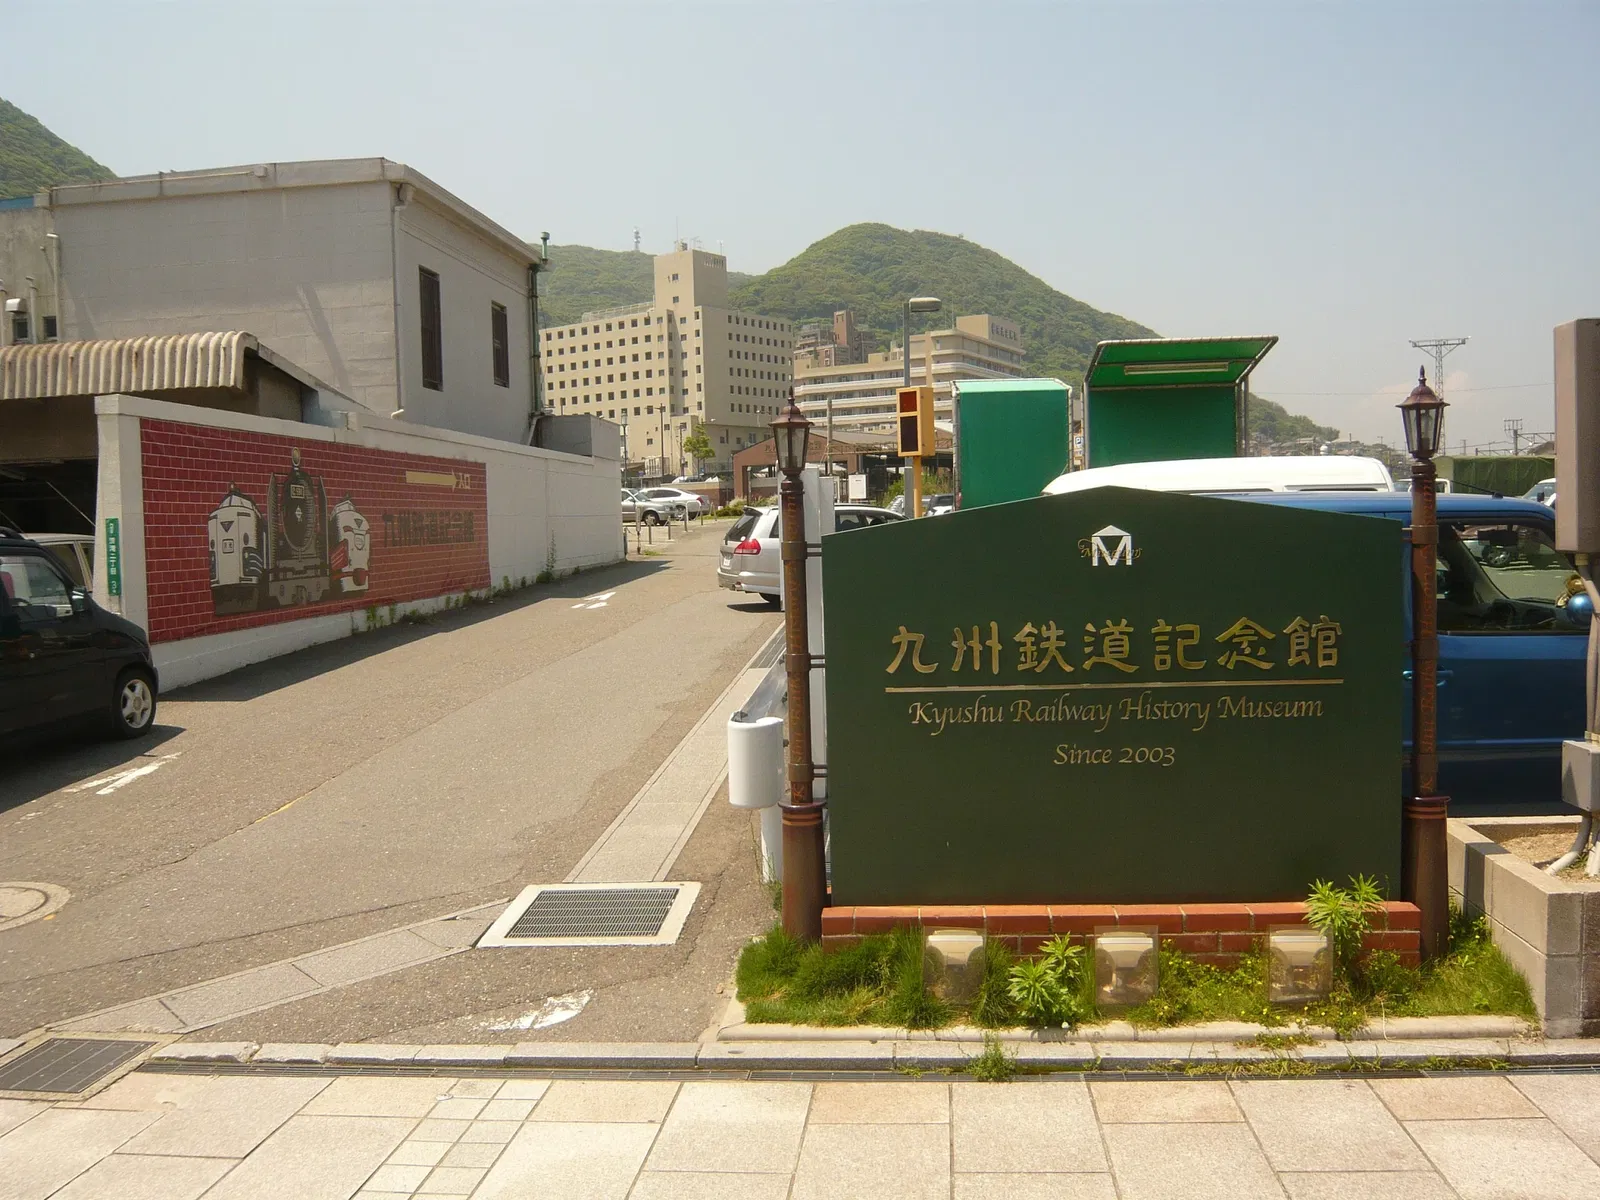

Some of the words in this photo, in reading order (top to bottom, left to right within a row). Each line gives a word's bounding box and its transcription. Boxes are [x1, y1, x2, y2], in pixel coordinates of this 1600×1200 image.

[885, 614, 1342, 675] 九州鉄道記念館
[908, 694, 1004, 736] Kyushu
[1010, 693, 1113, 733] Railway
[1118, 690, 1211, 732] History
[1217, 695, 1324, 719] Museum
[1053, 743, 1112, 765] Since
[1118, 746, 1175, 767] 2003
